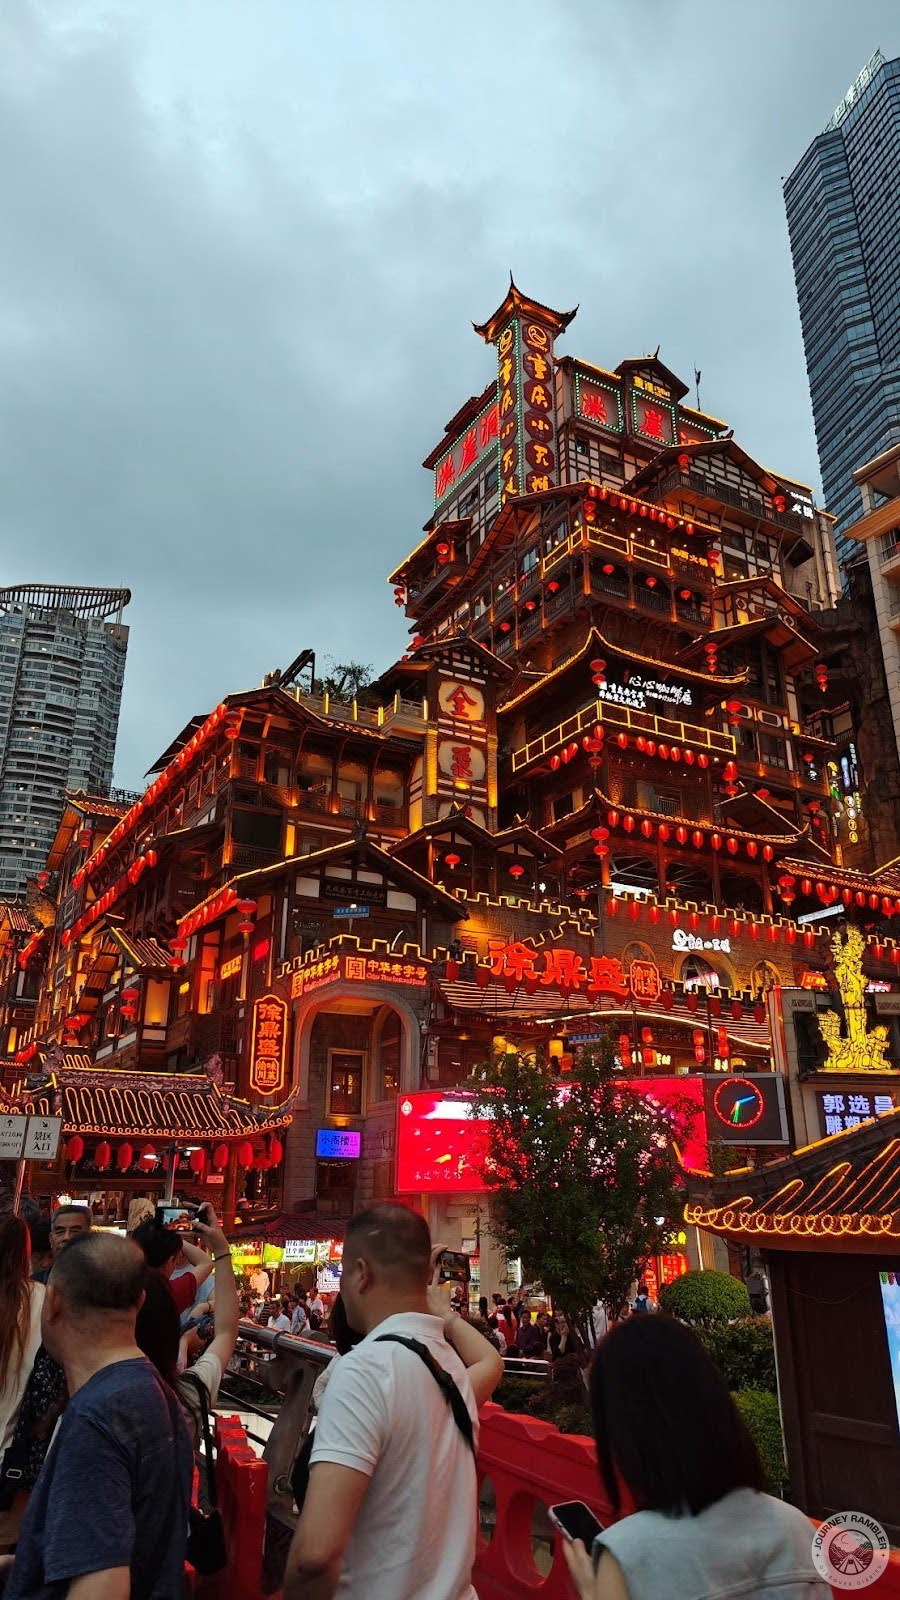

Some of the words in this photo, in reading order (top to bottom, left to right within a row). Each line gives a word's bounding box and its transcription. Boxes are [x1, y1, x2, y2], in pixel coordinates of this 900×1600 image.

[304, 955, 339, 983] 中华老字号
[368, 960, 427, 979] 中华老字号
[487, 940, 629, 996] 徐鼎盛
[257, 1003, 283, 1057] 徐鼎盛
[823, 1094, 895, 1114] 郭选昌
[34, 1131, 52, 1140] 景区
[32, 1142, 51, 1151] 入口
